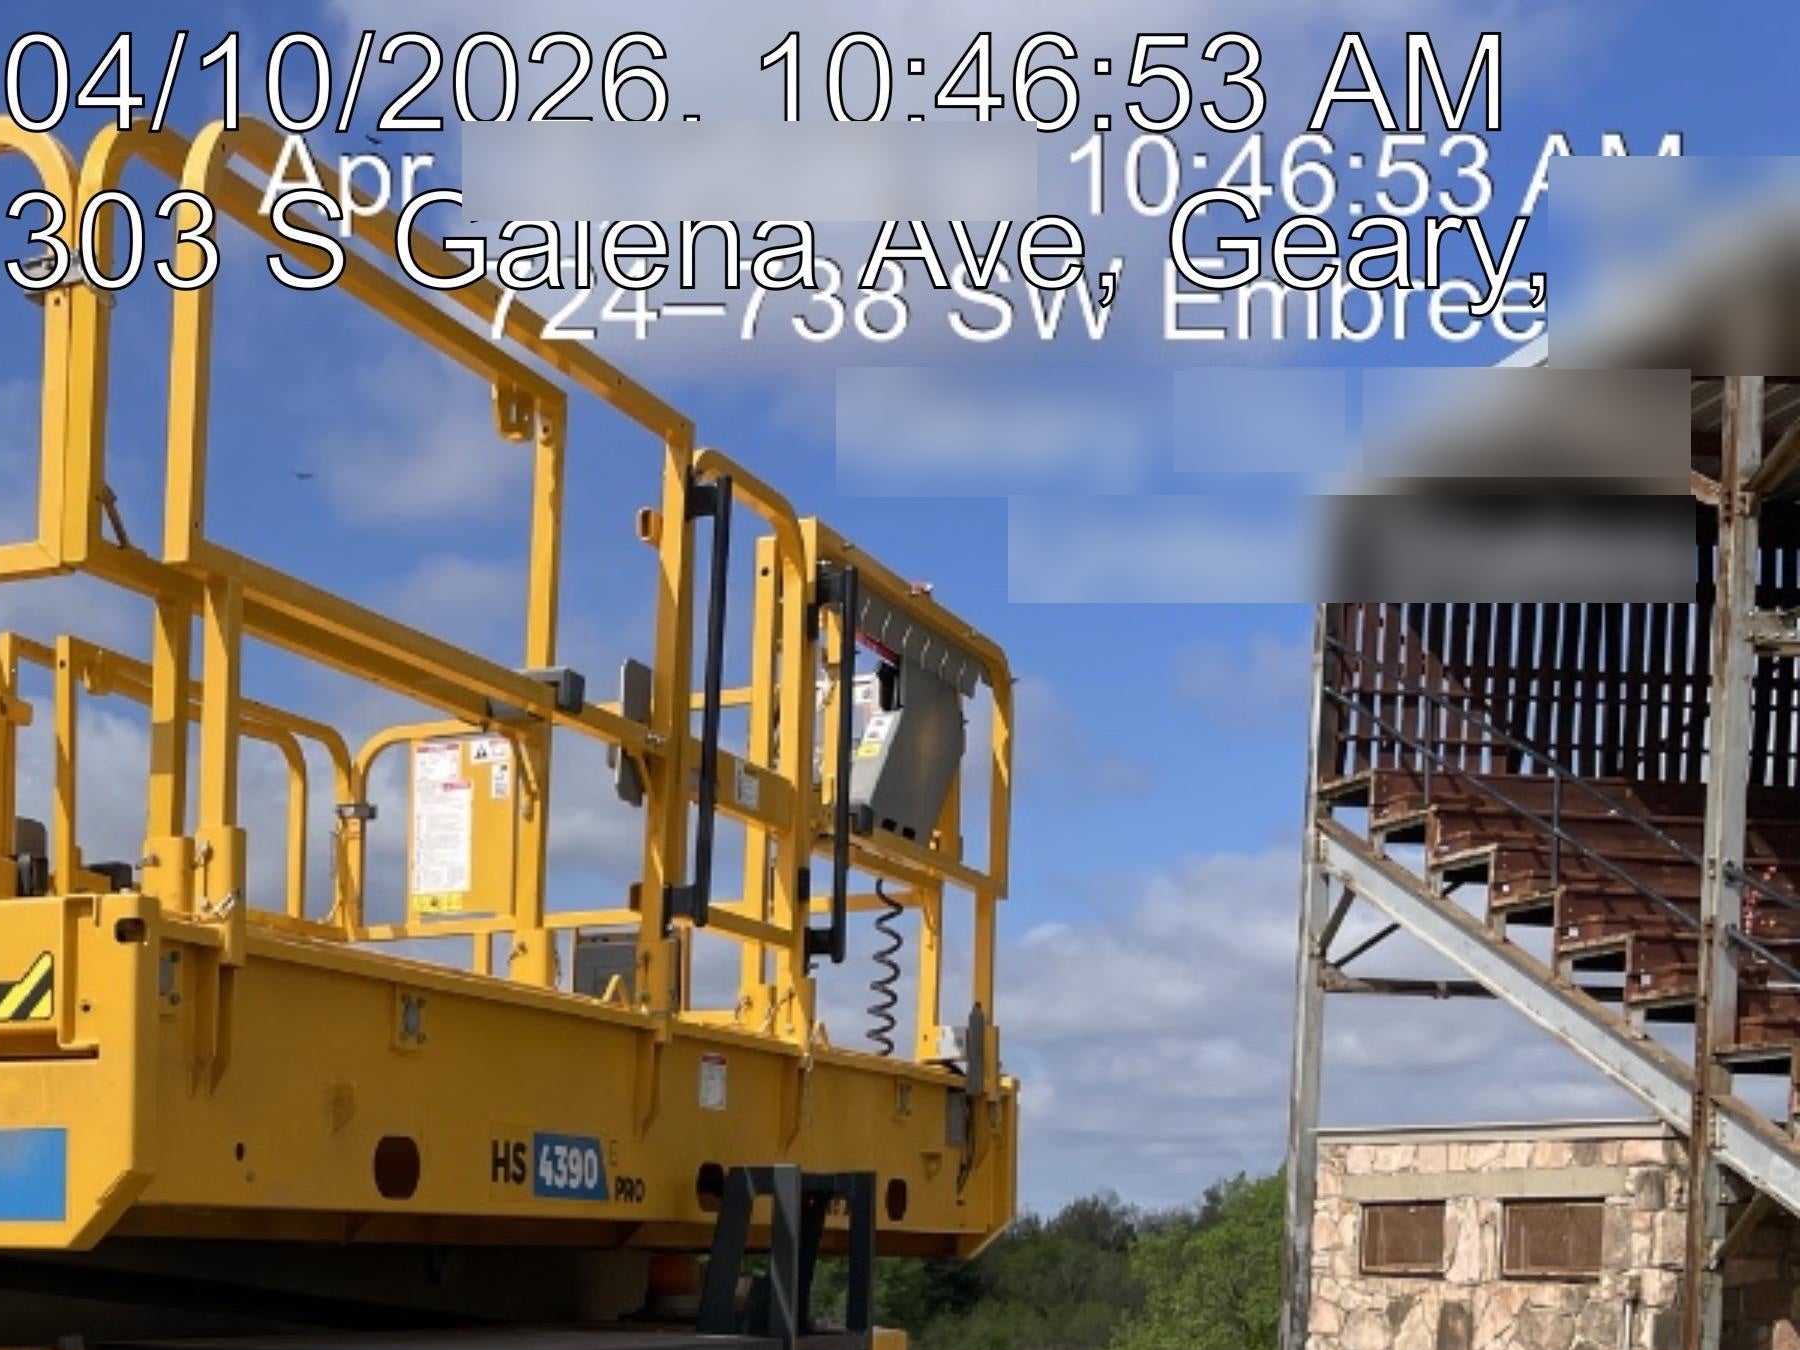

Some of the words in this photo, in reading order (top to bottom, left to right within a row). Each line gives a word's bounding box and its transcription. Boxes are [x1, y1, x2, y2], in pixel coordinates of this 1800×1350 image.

[491, 1139, 526, 1185] HS
[538, 1144, 599, 1190] 4390
[614, 1175, 646, 1204] PRO
